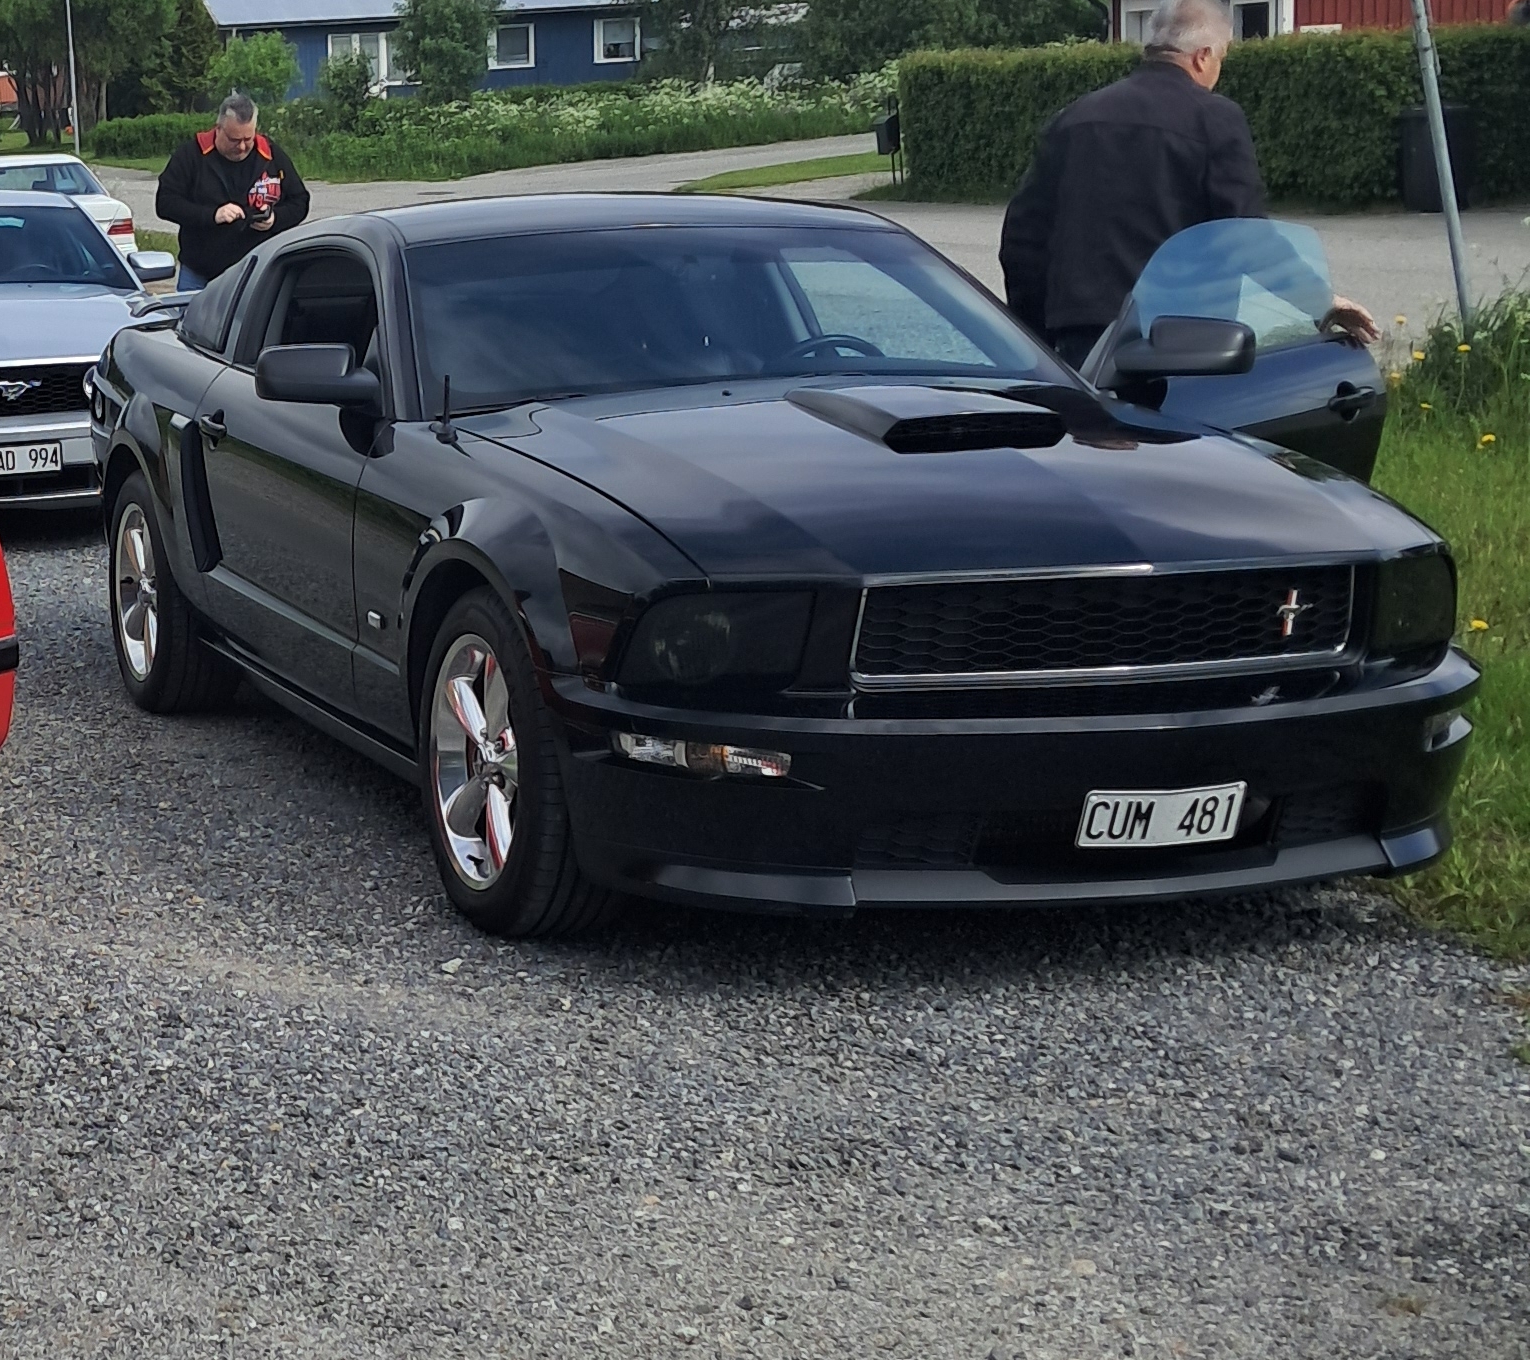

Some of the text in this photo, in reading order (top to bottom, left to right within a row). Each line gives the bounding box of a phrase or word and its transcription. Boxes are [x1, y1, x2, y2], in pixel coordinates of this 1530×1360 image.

[28, 446, 59, 469] 994
[1085, 793, 1236, 840] CUM 481
